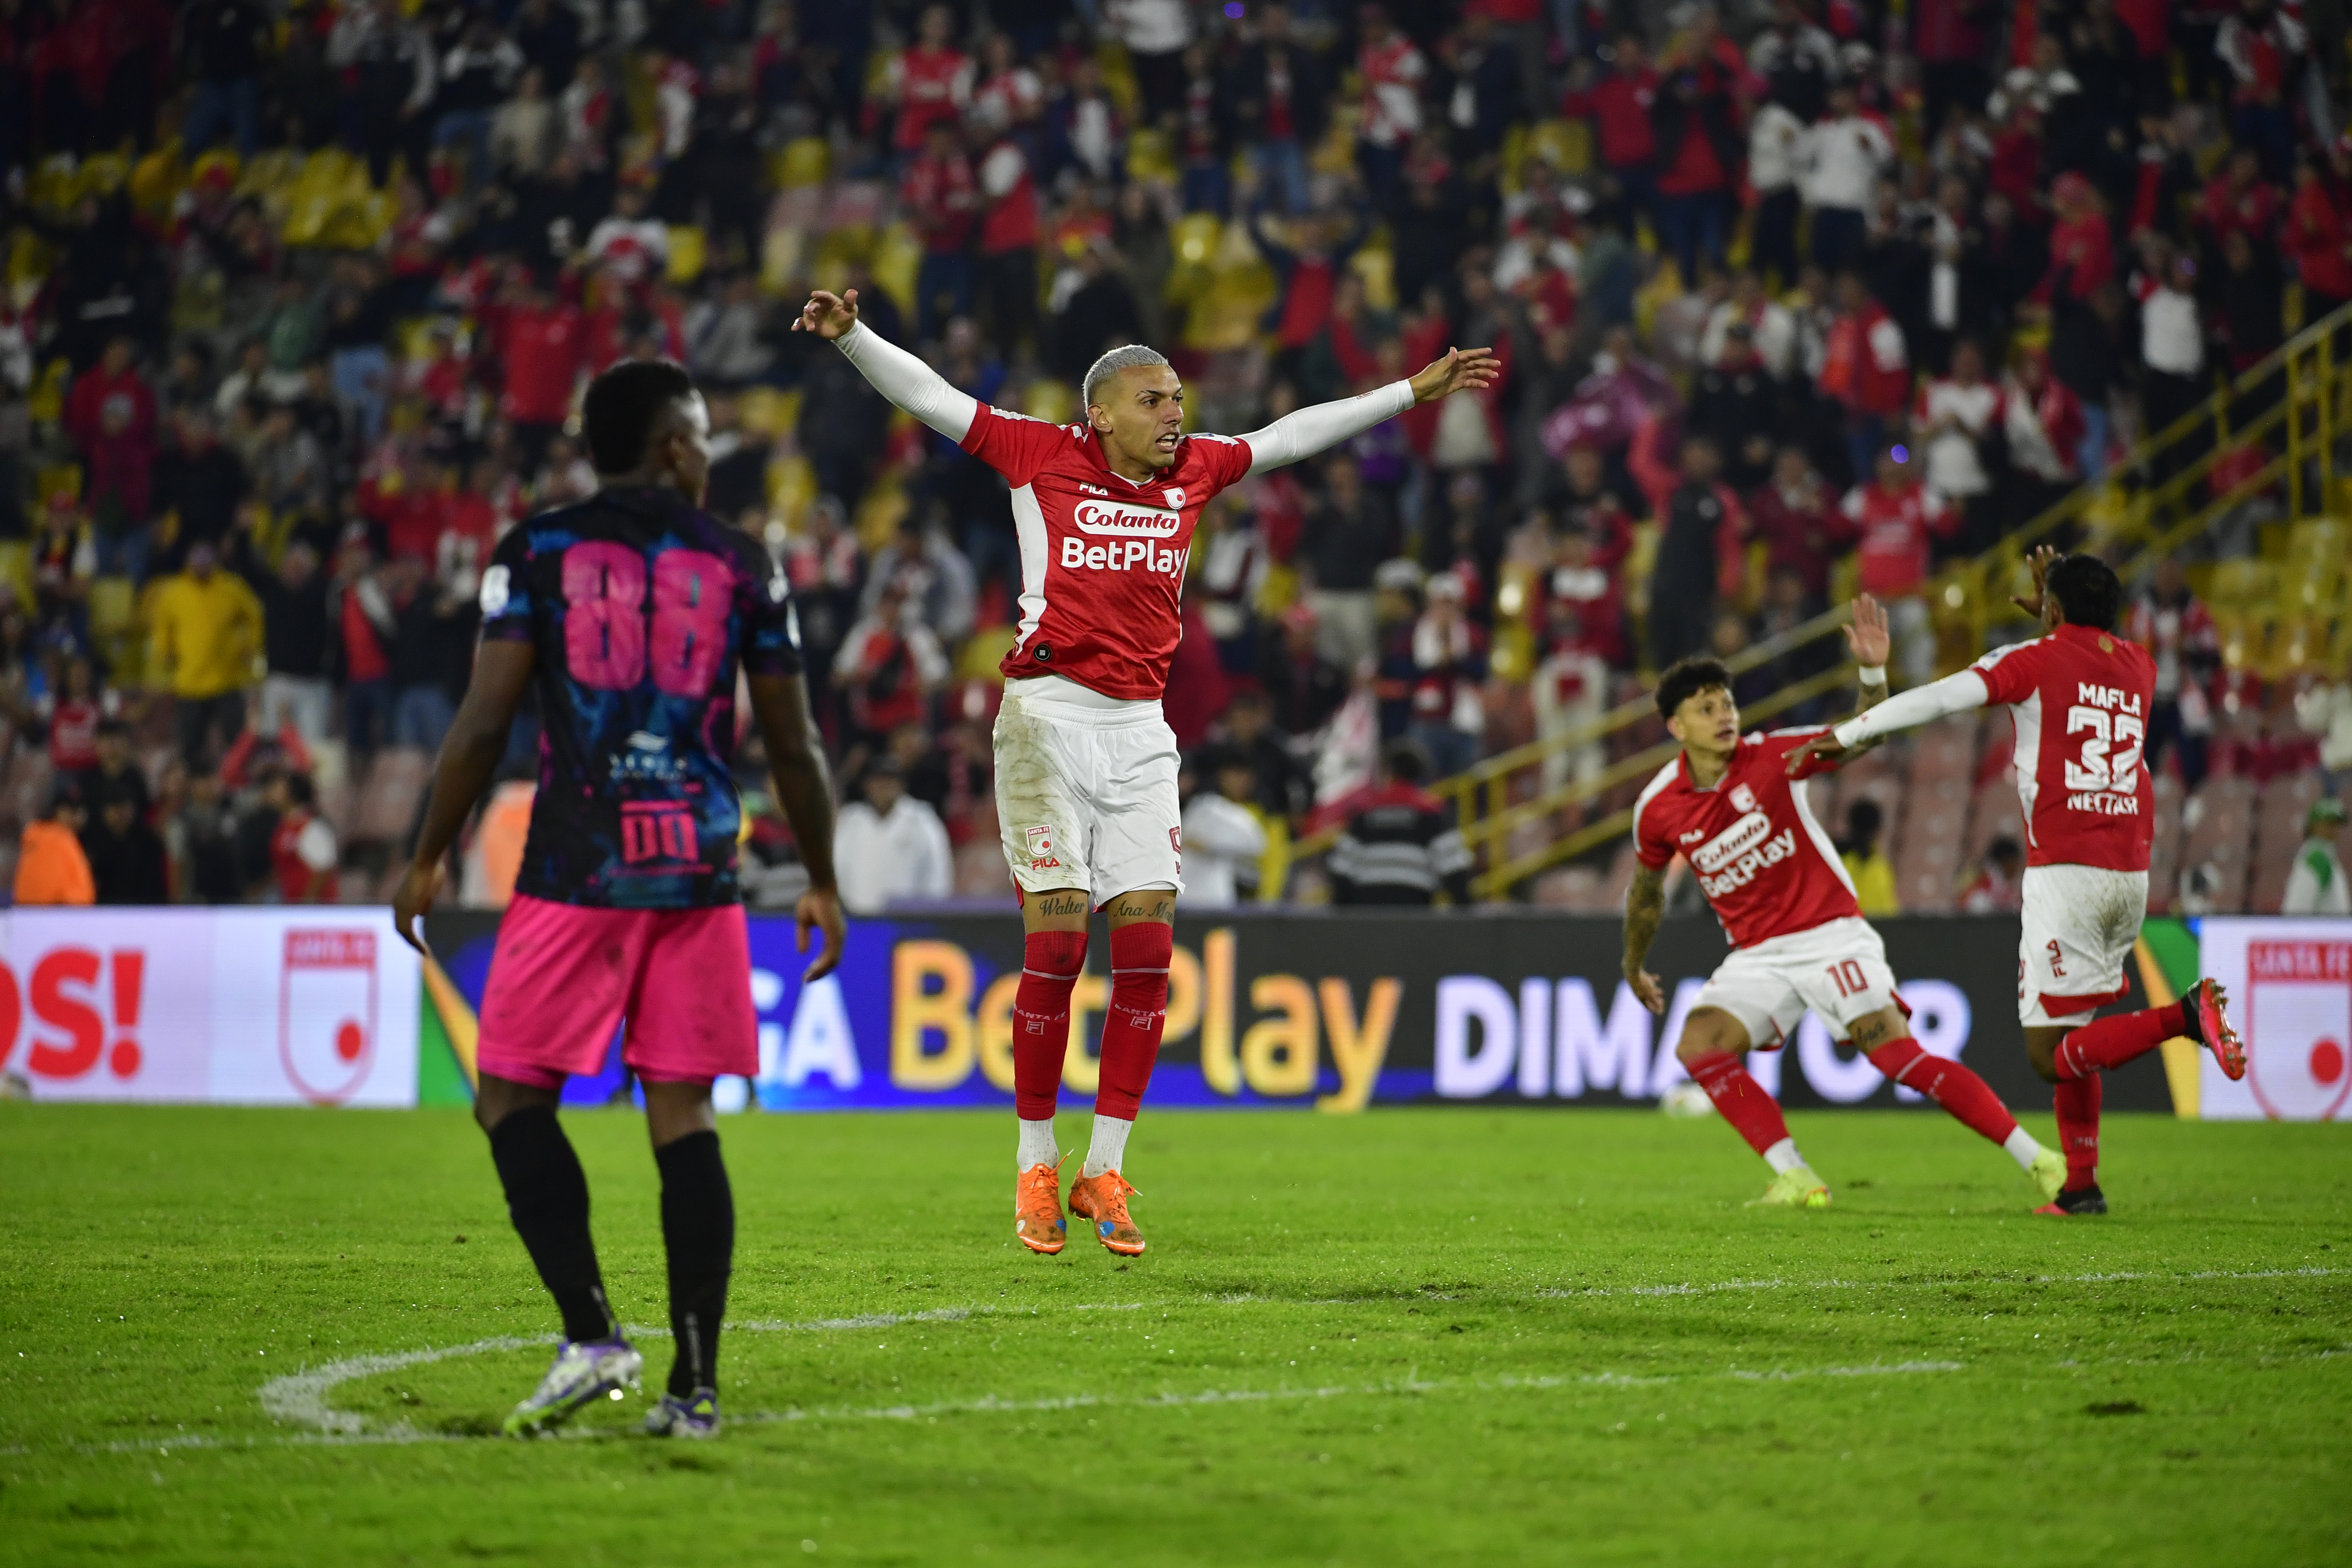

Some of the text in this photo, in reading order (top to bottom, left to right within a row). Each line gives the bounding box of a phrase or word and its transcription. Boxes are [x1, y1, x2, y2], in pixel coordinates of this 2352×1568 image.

[1079, 482, 1108, 496] FILA
[1078, 506, 1176, 530] Colanta
[1061, 536, 1186, 578] BetPlay
[561, 539, 735, 700] 88
[2078, 681, 2141, 716] MAFLA
[2065, 705, 2143, 795] 32
[1032, 858, 1060, 871] FILA
[1699, 827, 1796, 898] BetPlay
[1039, 896, 1085, 917] Walter
[1113, 900, 1146, 917] Ana
[2047, 939, 2066, 978] FILA
[1826, 959, 1868, 997] 10
[0, 946, 144, 1080] S!
